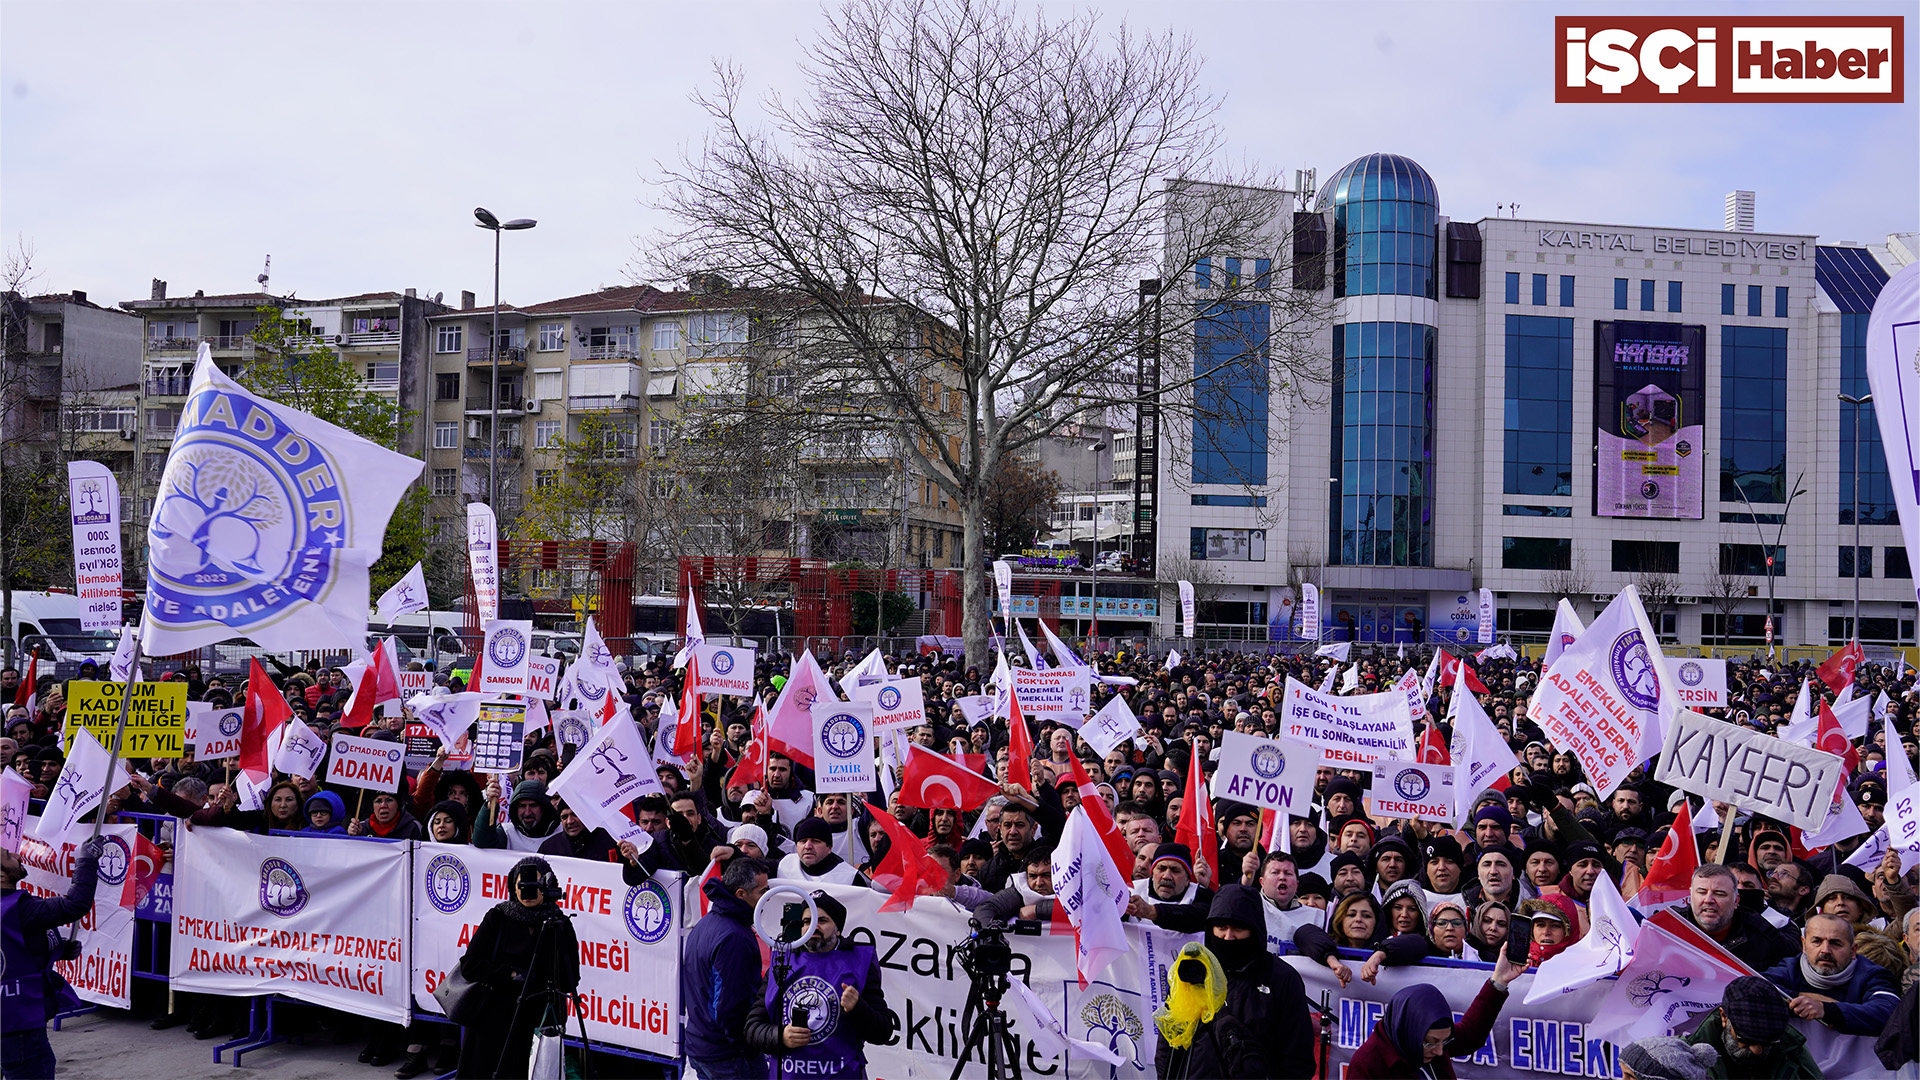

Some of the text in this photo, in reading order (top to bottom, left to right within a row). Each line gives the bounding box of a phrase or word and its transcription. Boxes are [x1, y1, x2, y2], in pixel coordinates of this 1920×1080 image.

[1538, 229, 1807, 260] KARTAL BELEDİYESİ
[177, 394, 345, 531] MADDER
[1018, 558, 1079, 566] RESTAURANT
[195, 573, 227, 583] 2023
[101, 683, 156, 698] OYUM
[400, 674, 426, 688] YUM
[486, 676, 522, 684] SAMSUN
[80, 696, 174, 712] KADEMELİ
[1295, 689, 1361, 716] 1 GÜN 1 YIL
[1678, 688, 1717, 702] ERSİN
[1021, 703, 1063, 711] ELSİN!!!
[70, 711, 182, 727] EMEKLİLİĞE
[824, 715, 847, 736] EMADDER
[1292, 704, 1396, 732] İŞE GEÇ BAŞLAYANA
[1548, 672, 1639, 769] ADALET DERNEĞİ
[410, 726, 421, 736] 17
[424, 726, 438, 736] YI
[1290, 725, 1408, 750] 17 YIL SONRA EMEKLİLİK
[1559, 701, 1620, 768] TEKİRDAĞ
[129, 734, 149, 751] 17
[154, 734, 182, 751] YIL
[204, 738, 242, 756] ADAN
[1530, 702, 1611, 792] İL TEMSİLCİLİĞİ
[332, 758, 394, 784] ADANA
[821, 774, 869, 783] TEMSİLCİLİĞİ
[829, 762, 861, 774] İZMİR
[1667, 725, 1824, 817] KAYSERİ
[1228, 774, 1293, 808] AFYON
[1378, 800, 1446, 817] TEKİRDAĞ
[283, 864, 302, 890] ADANA
[179, 915, 401, 962] EMEKLİLİKTE ADALET DERNEĞİ
[189, 947, 383, 996] ADANA TEMSİLCİLİĞİ
[786, 979, 837, 1002] EMADDER
[1150, 977, 1158, 1006] ADALET
[782, 1056, 844, 1075] ÖREVLİ
